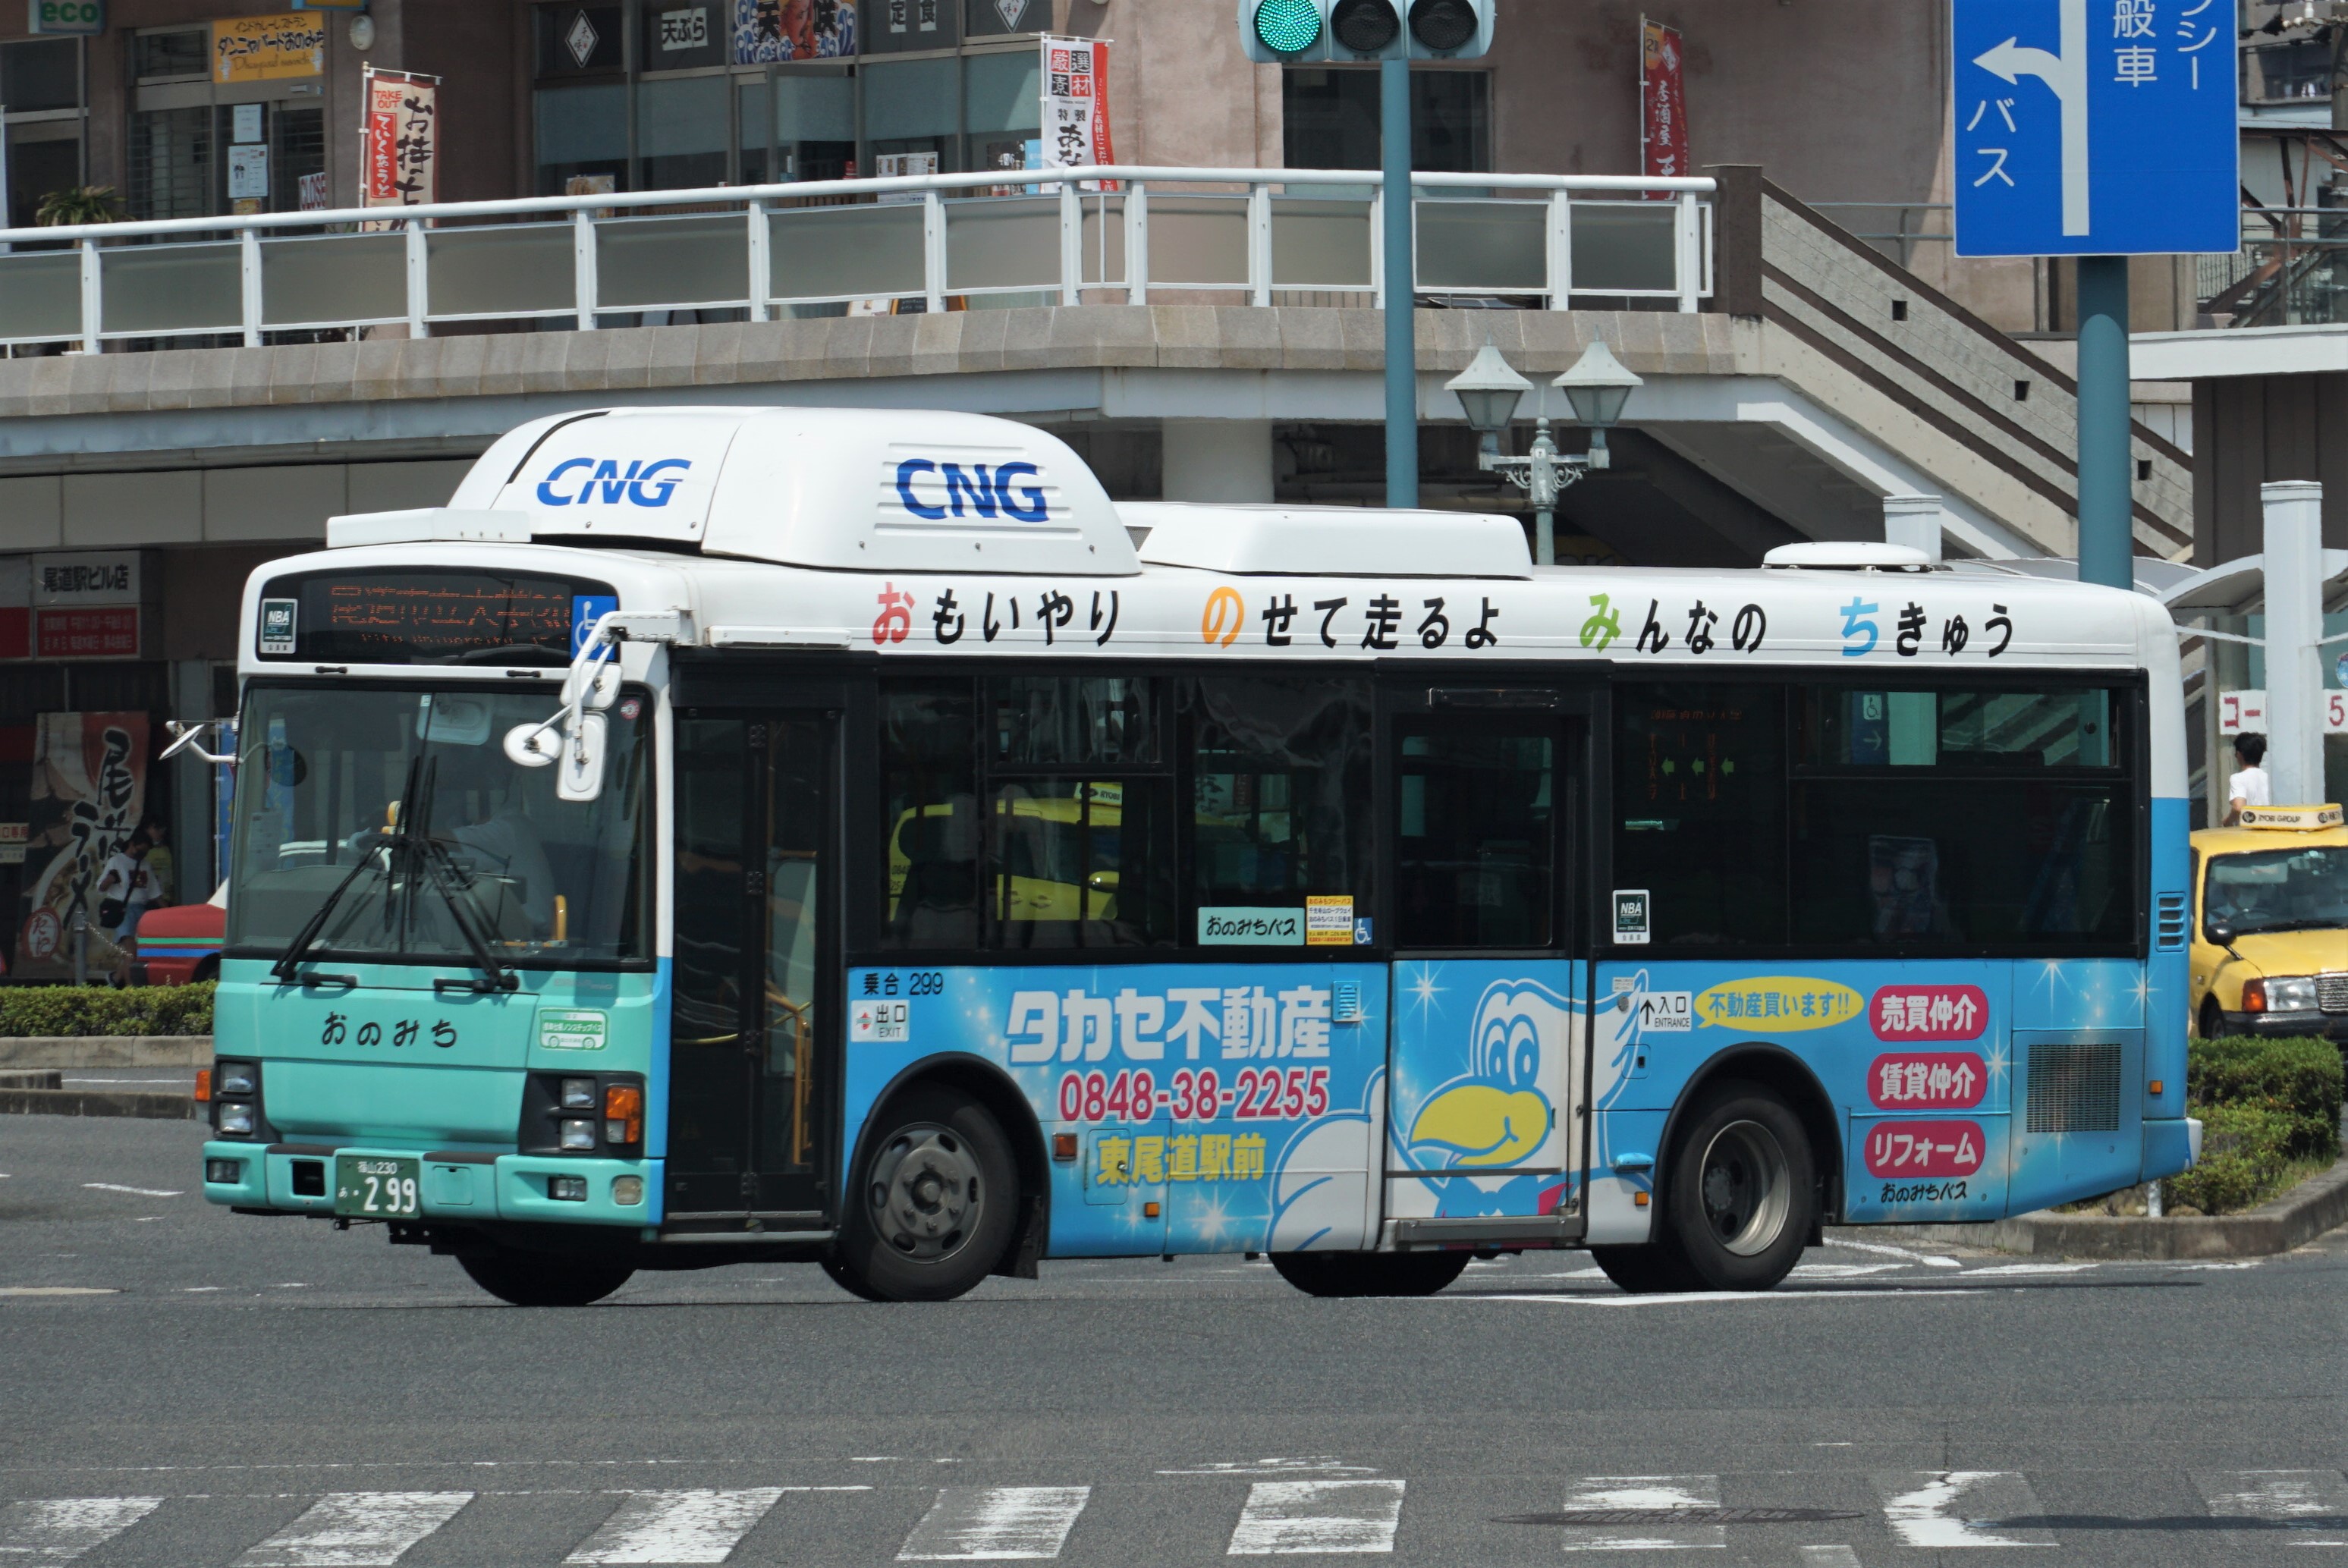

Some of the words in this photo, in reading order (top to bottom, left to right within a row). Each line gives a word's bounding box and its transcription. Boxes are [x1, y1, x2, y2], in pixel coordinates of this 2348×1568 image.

[41, 2, 98, 23] eco
[662, 17, 705, 45] 天ぷら
[2113, 0, 2158, 87] 般車
[1051, 51, 1091, 72] 厳選
[375, 90, 403, 100] TAKE
[1052, 75, 1091, 95] 素材
[378, 99, 401, 108] OUT
[394, 96, 435, 206] お持ち
[1966, 98, 2017, 187] バス
[537, 457, 693, 507] CNG
[896, 457, 1051, 523] CNG
[43, 564, 129, 592] 尾道駅ビル店
[268, 611, 290, 623] NBA
[871, 581, 1121, 647] おもいやり
[1201, 586, 1501, 651] のせて走るよ
[1579, 592, 1768, 654] みんなの
[1839, 595, 2013, 658] ちきゅう
[2277, 815, 2302, 823] GROUP
[1620, 902, 1642, 914] NBA
[1205, 915, 1297, 936] おのみちバス
[863, 973, 900, 996] 乗合
[909, 973, 944, 996] 299
[875, 1003, 906, 1024] 出口
[1658, 996, 1687, 1014] 入口
[1880, 994, 1978, 1032] 売買仲介
[321, 1011, 457, 1048] おのみち
[879, 1026, 902, 1039] EXIT
[1006, 985, 1331, 1064] タカセ不動産
[1655, 1017, 1690, 1028] ENTRANCE
[1879, 1061, 1976, 1101] 賃貸仲介
[1059, 1069, 1329, 1121] 0848-38-2255
[1095, 1132, 1267, 1186] 東尾道駅前
[1874, 1132, 1977, 1167] リフォーム
[1880, 1181, 1968, 1203] おのみちバス
